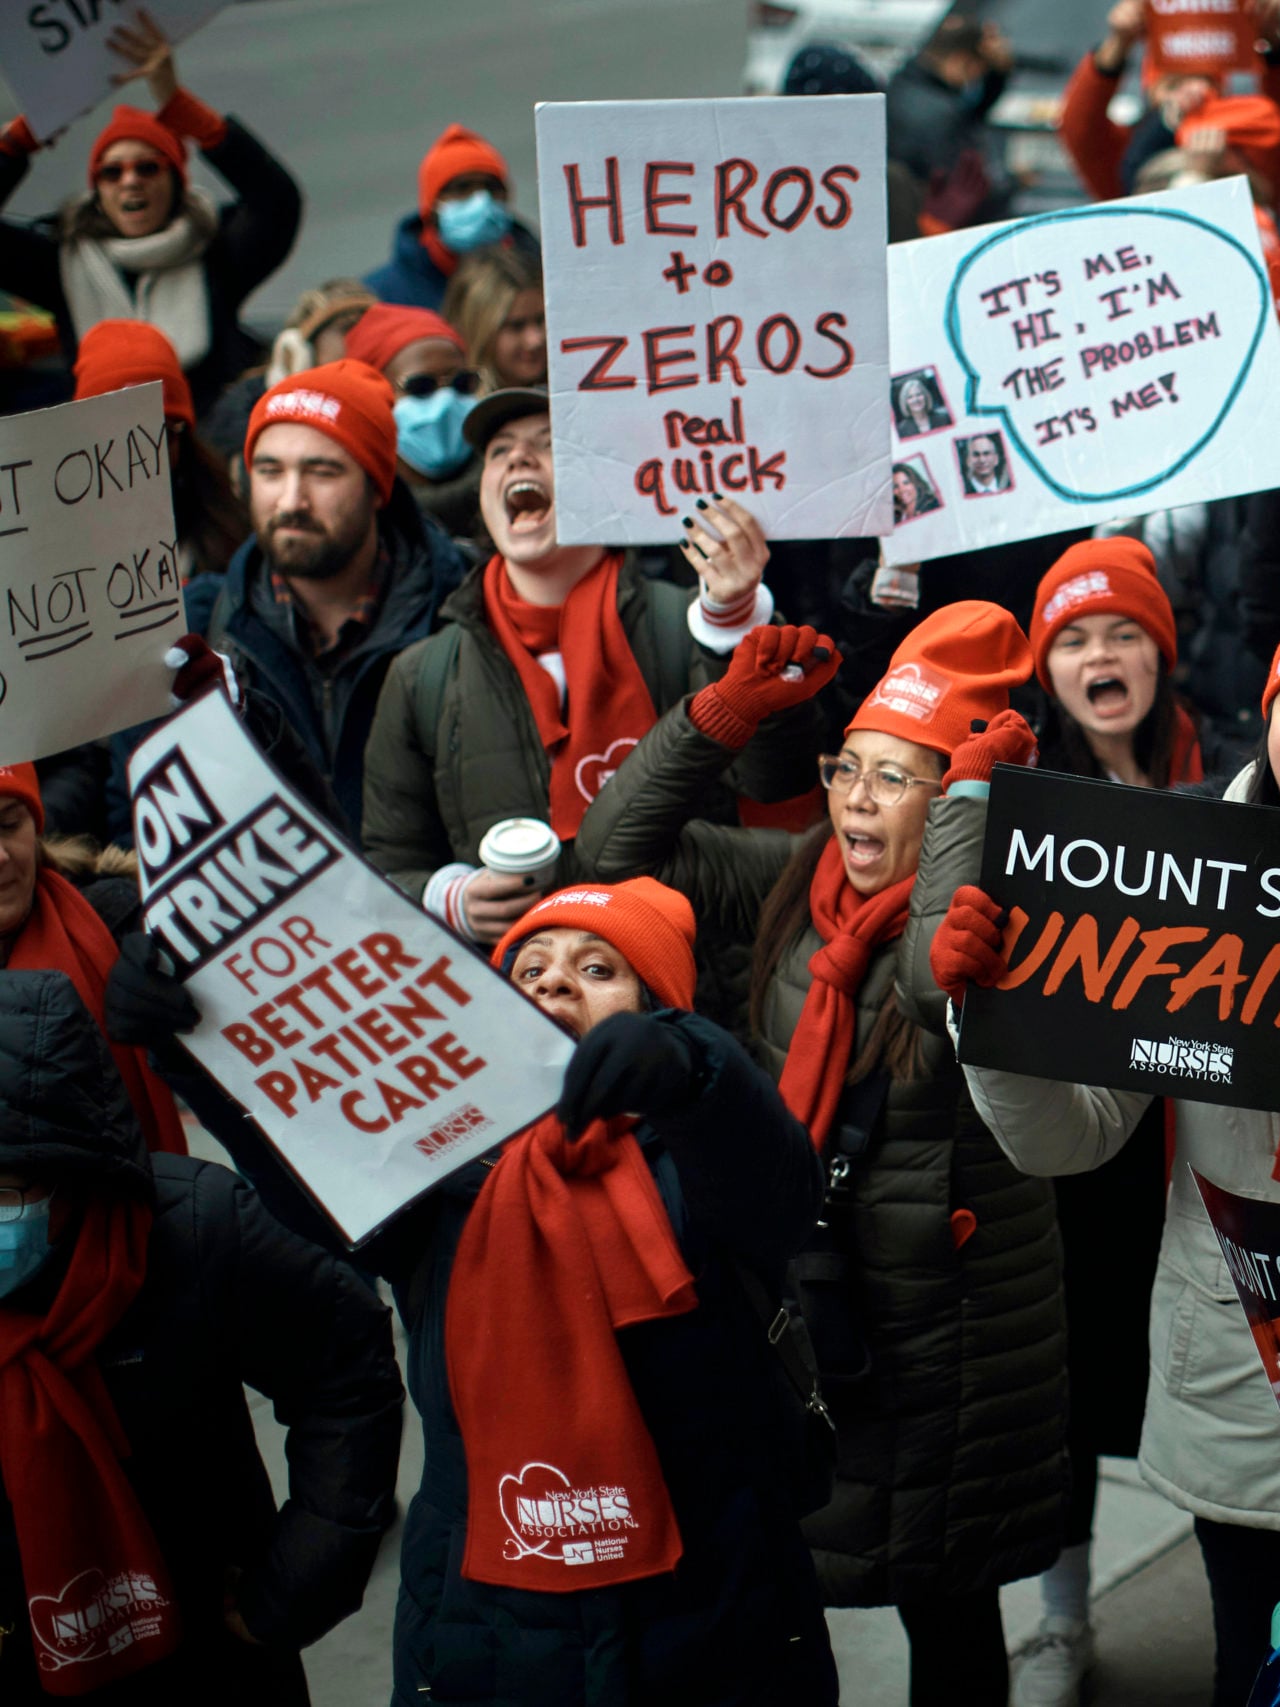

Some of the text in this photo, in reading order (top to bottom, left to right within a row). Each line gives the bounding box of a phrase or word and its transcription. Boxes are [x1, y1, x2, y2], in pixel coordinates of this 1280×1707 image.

[563, 156, 860, 248] HEROS
[662, 251, 733, 294] to
[980, 270, 1062, 318] IT'S
[1099, 272, 1182, 321] I'M
[560, 311, 855, 396] ZEROS
[1003, 311, 1222, 399] THE PROBLEM
[664, 397, 745, 448] real
[1034, 371, 1179, 446] IT'S ME!
[54, 422, 167, 505] OKAY
[634, 446, 786, 516] quick
[8, 540, 181, 636] NOT OKAY
[136, 763, 212, 867] ON
[145, 806, 331, 977] TRIKE
[1005, 828, 1247, 911] MOUNT
[222, 915, 332, 997] FOR
[219, 932, 423, 1068] BETTER
[254, 955, 473, 1119] PATIENT
[1131, 1038, 1234, 1075] NURSES
[1168, 1035, 1233, 1055] New York State
[340, 1031, 488, 1134] CARE
[413, 1105, 486, 1156] NURSES
[517, 1495, 630, 1528] NURSES
[545, 1485, 626, 1501] New York State
[594, 1536, 628, 1548] National
[595, 1545, 623, 1555] Nurses
[597, 1552, 624, 1562] United
[52, 1580, 158, 1639] NURSES
